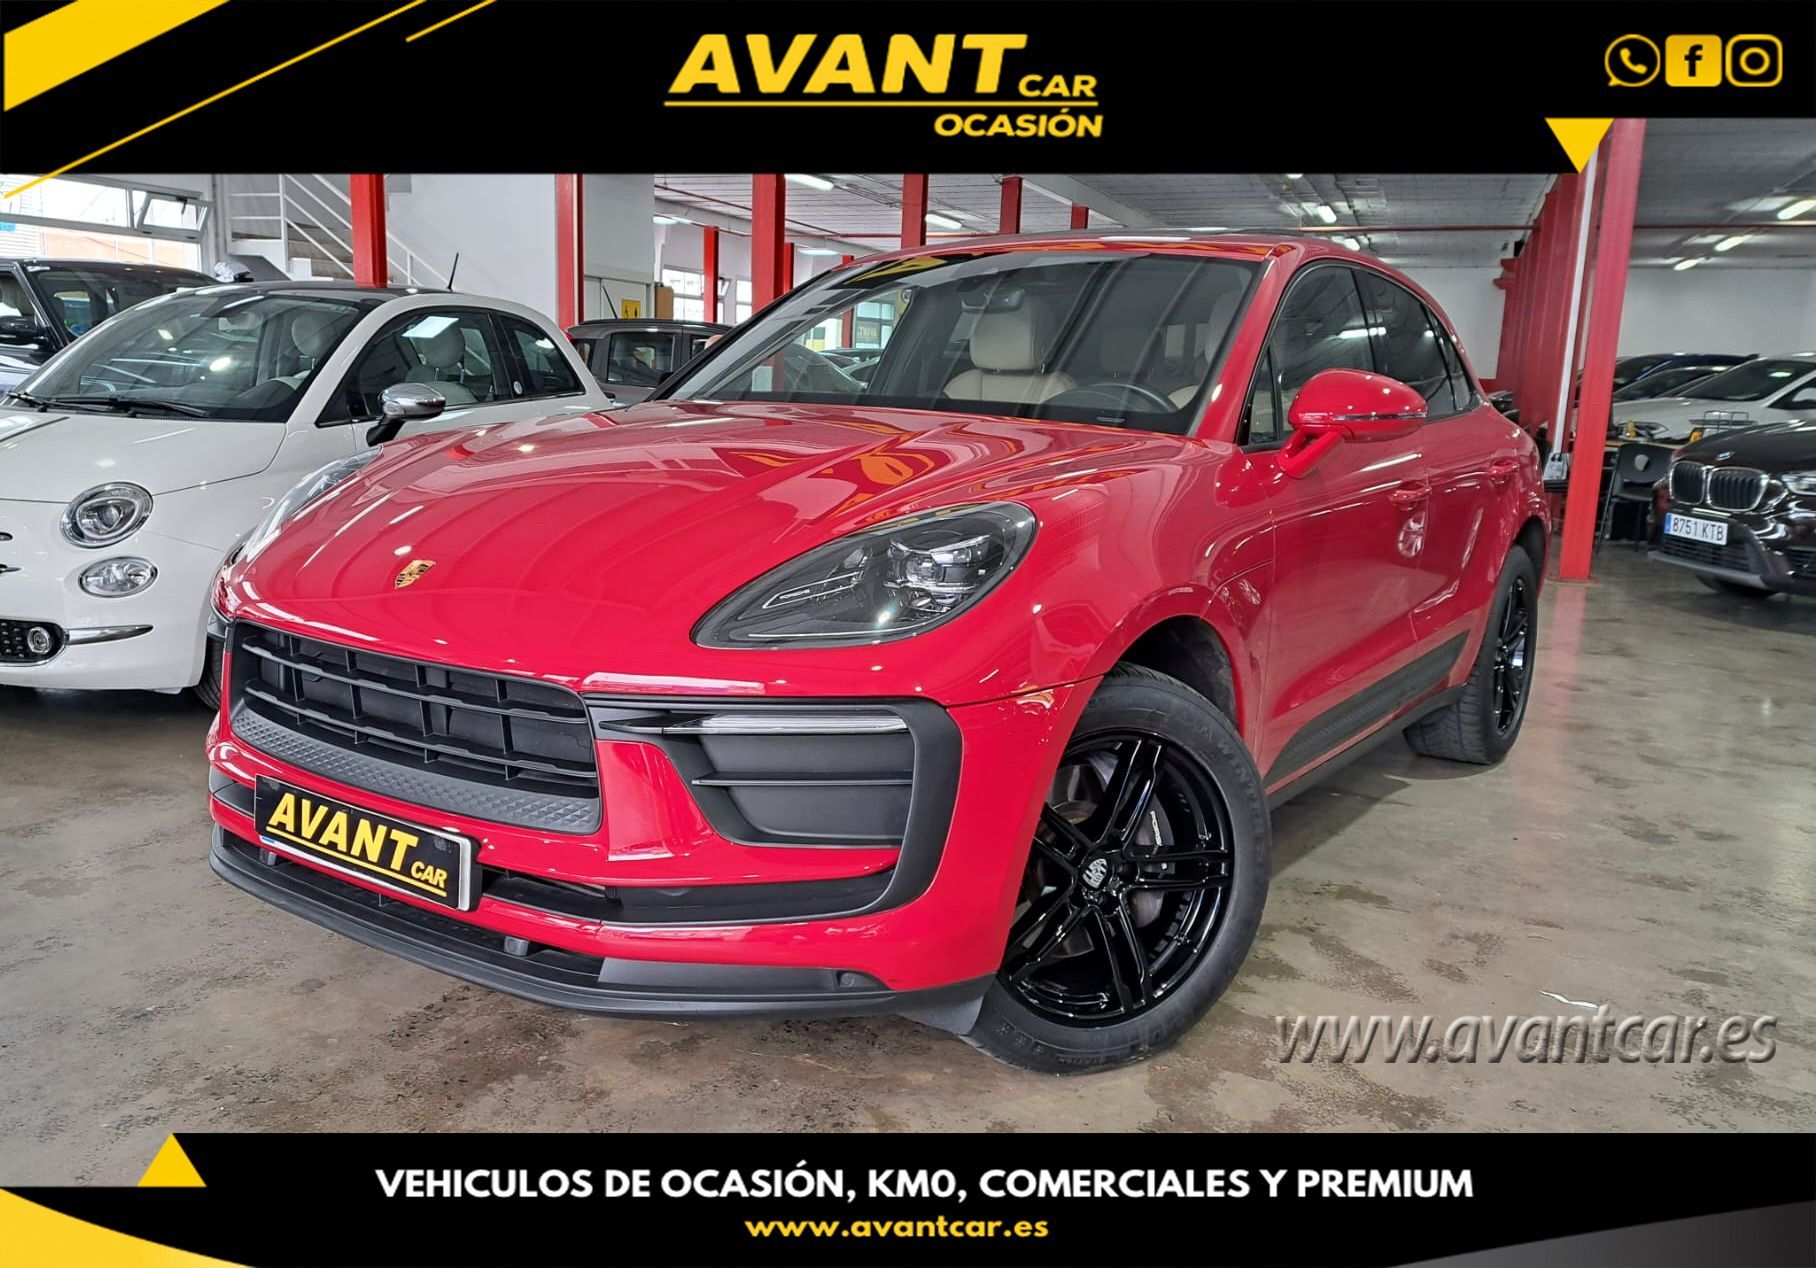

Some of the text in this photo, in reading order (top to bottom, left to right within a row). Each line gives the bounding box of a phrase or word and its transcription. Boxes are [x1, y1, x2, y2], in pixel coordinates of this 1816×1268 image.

[1673, 517, 1724, 541] 8751 KTB
[268, 792, 448, 889] AVANT CAR
